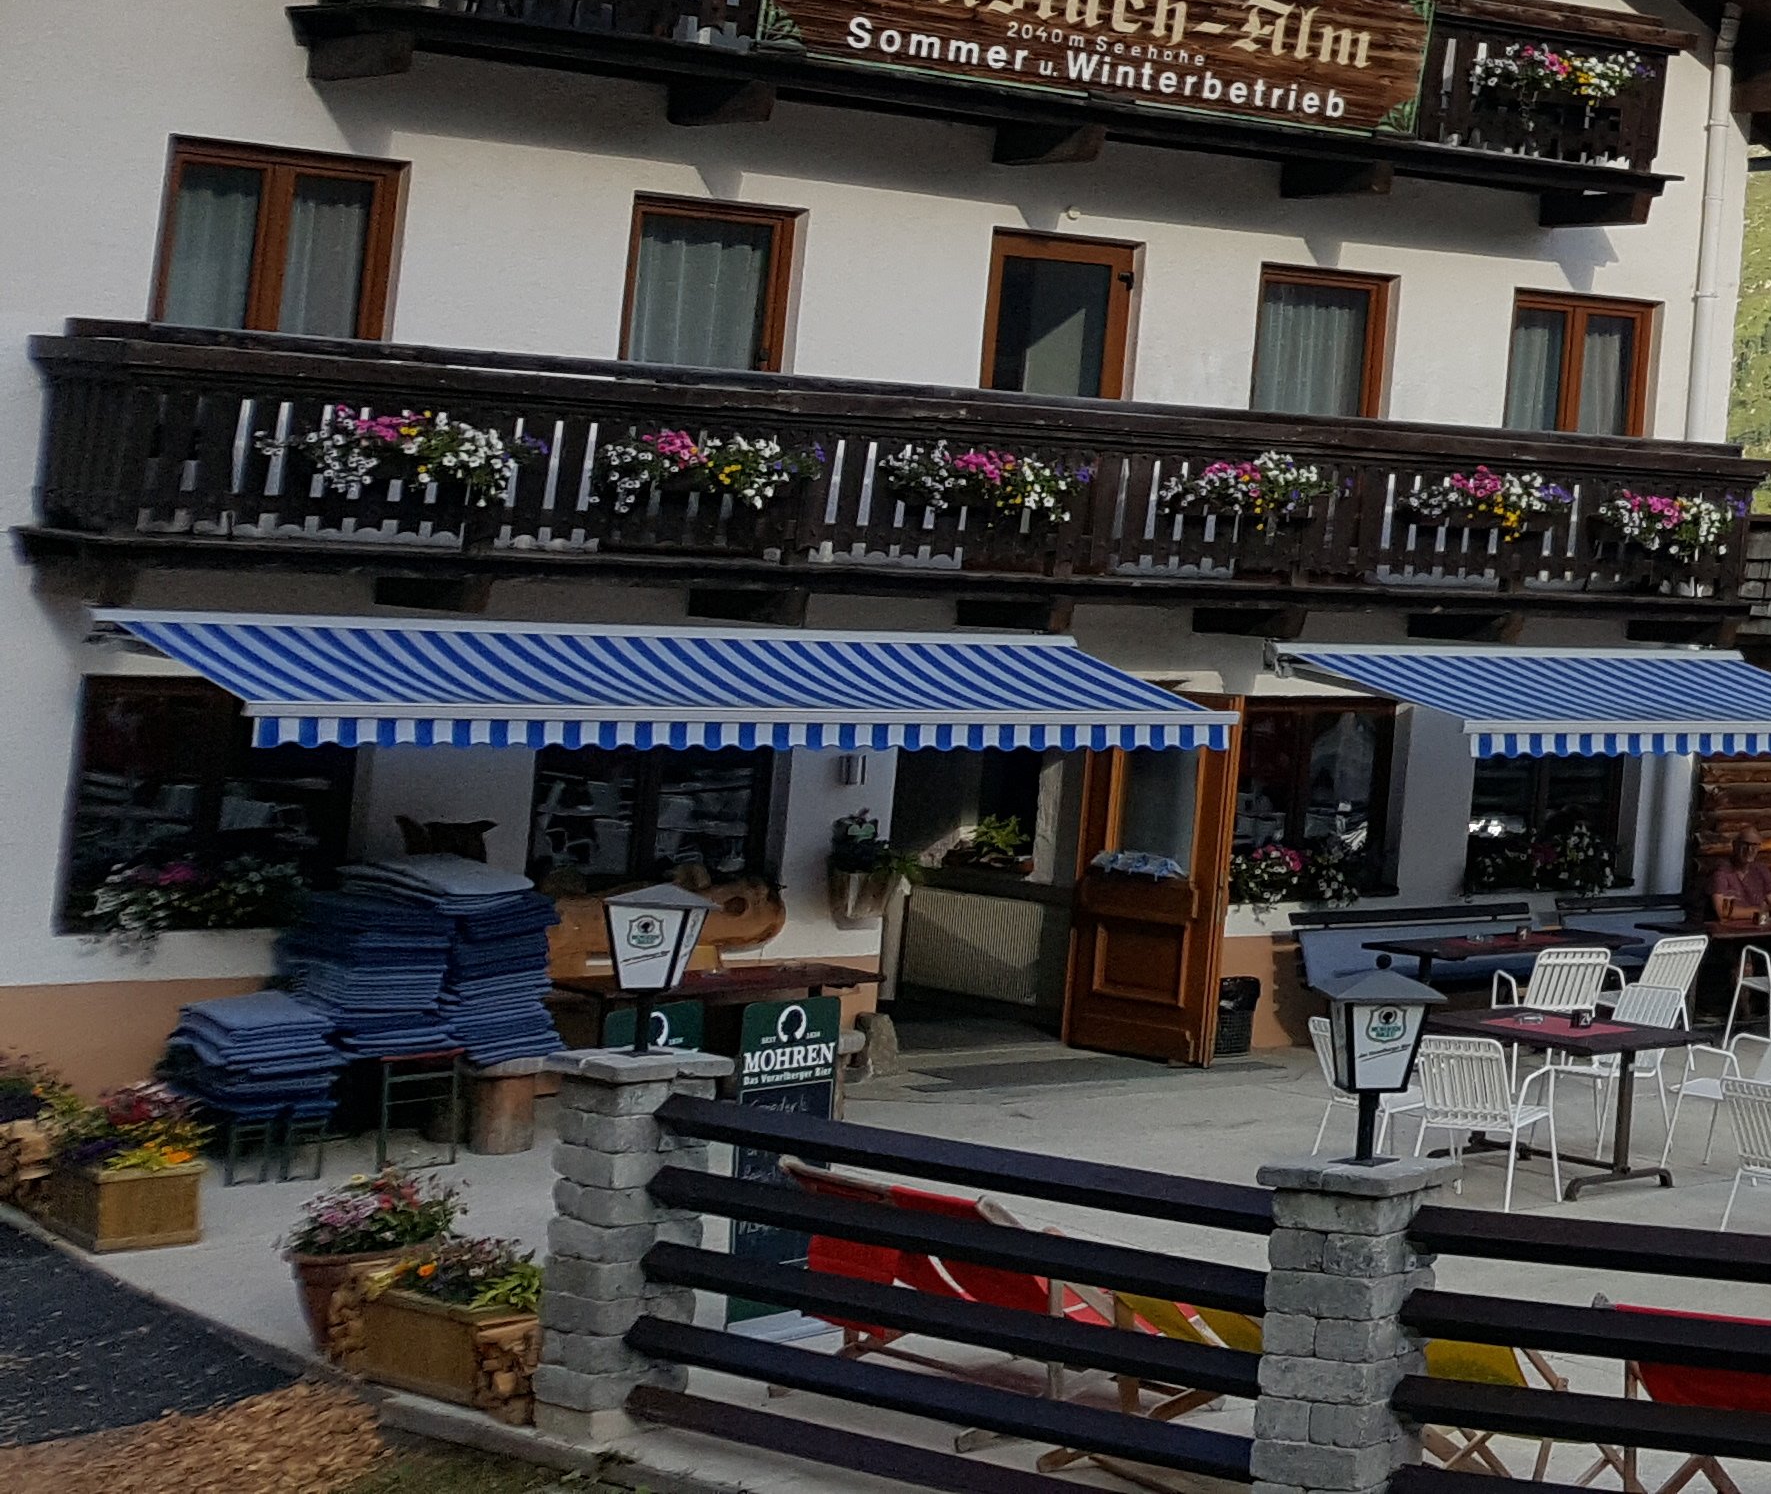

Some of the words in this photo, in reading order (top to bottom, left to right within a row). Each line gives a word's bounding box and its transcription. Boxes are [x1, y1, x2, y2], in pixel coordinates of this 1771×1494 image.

[1006, 21, 1063, 43] 2040
[1068, 34, 1085, 48] m
[846, 16, 1029, 72] Sommer
[1039, 59, 1059, 77] u.
[1066, 50, 1346, 118] Winterbetrieb
[742, 1042, 836, 1074] MOHREN
[743, 1075, 759, 1086] Das
[814, 1066, 832, 1077] Bier
